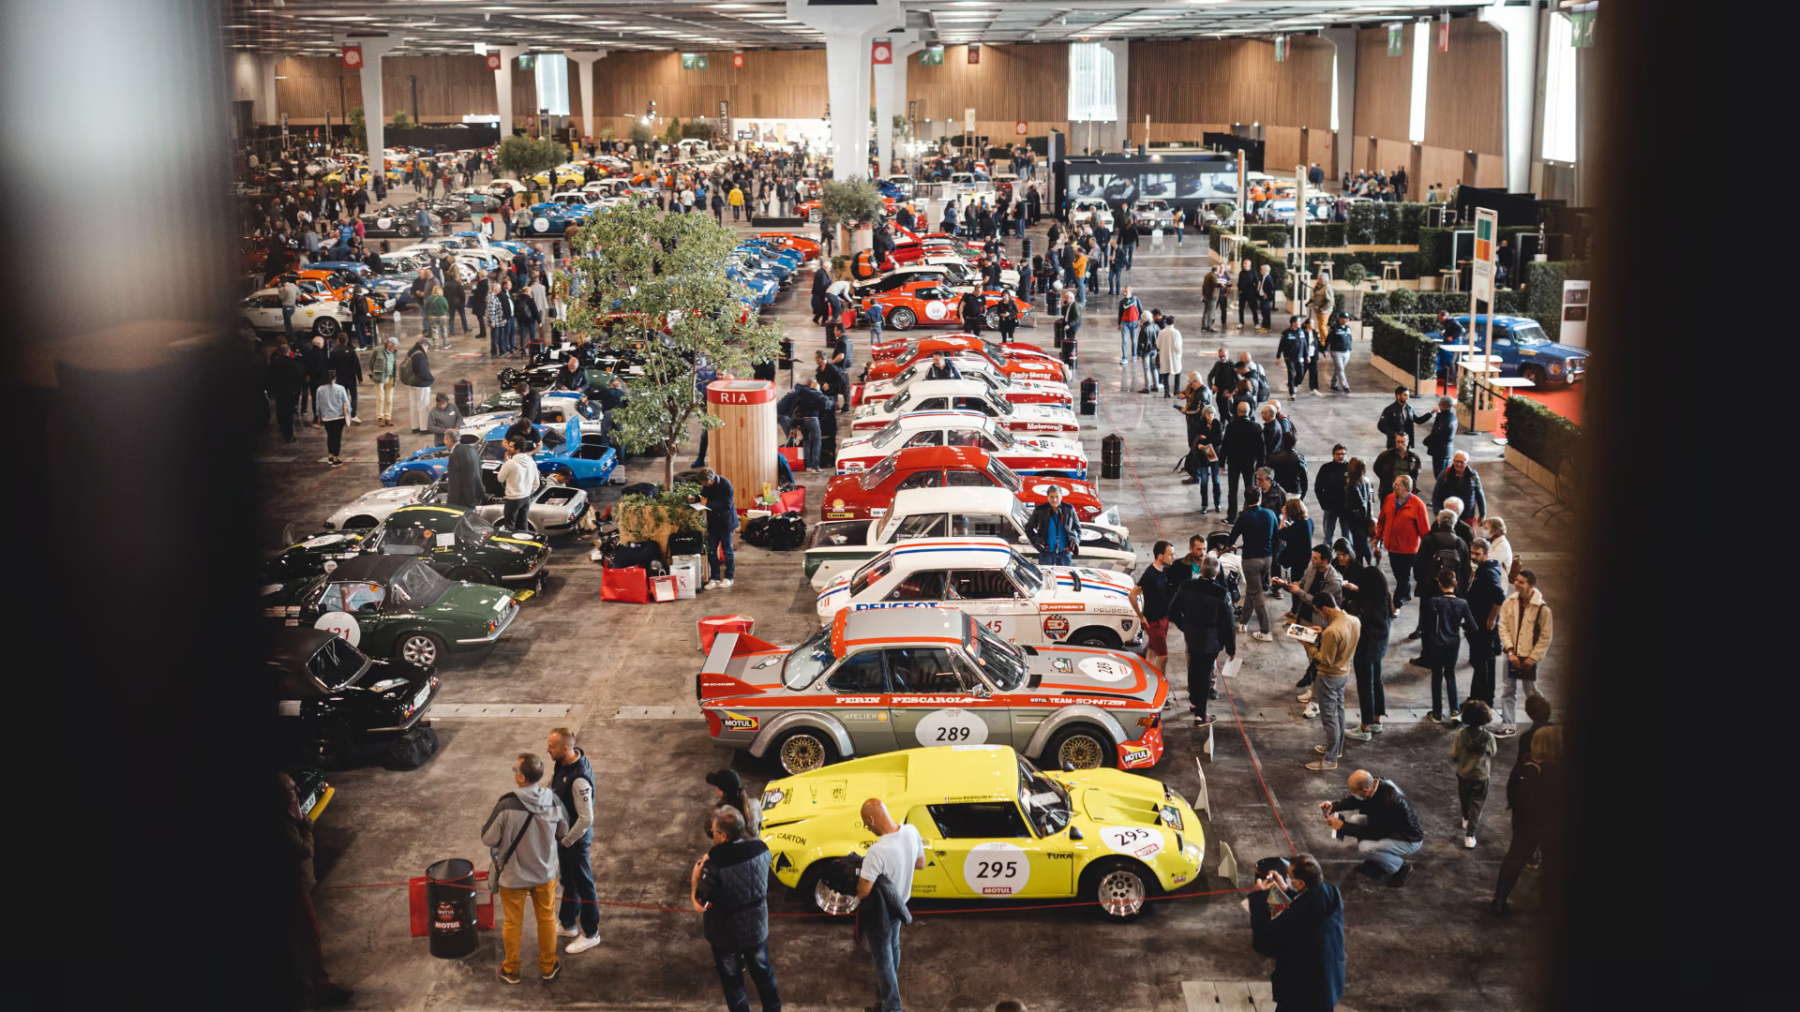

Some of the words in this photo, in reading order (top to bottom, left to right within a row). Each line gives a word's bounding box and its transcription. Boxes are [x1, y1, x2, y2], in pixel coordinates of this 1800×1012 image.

[720, 392, 748, 403] RIA
[1026, 423, 1063, 431] Motorcraft
[1096, 661, 1114, 675] 289
[891, 696, 975, 704] PESCAROLO
[1049, 697, 1127, 706] TEAM-SCHNITZER
[725, 719, 752, 727] MOTUL
[935, 726, 970, 742] 289
[1124, 750, 1148, 763] MOTUL
[776, 832, 807, 846] CARTON
[1114, 828, 1149, 846] 295
[1135, 844, 1159, 857] MOTUL
[976, 861, 1018, 879] 295
